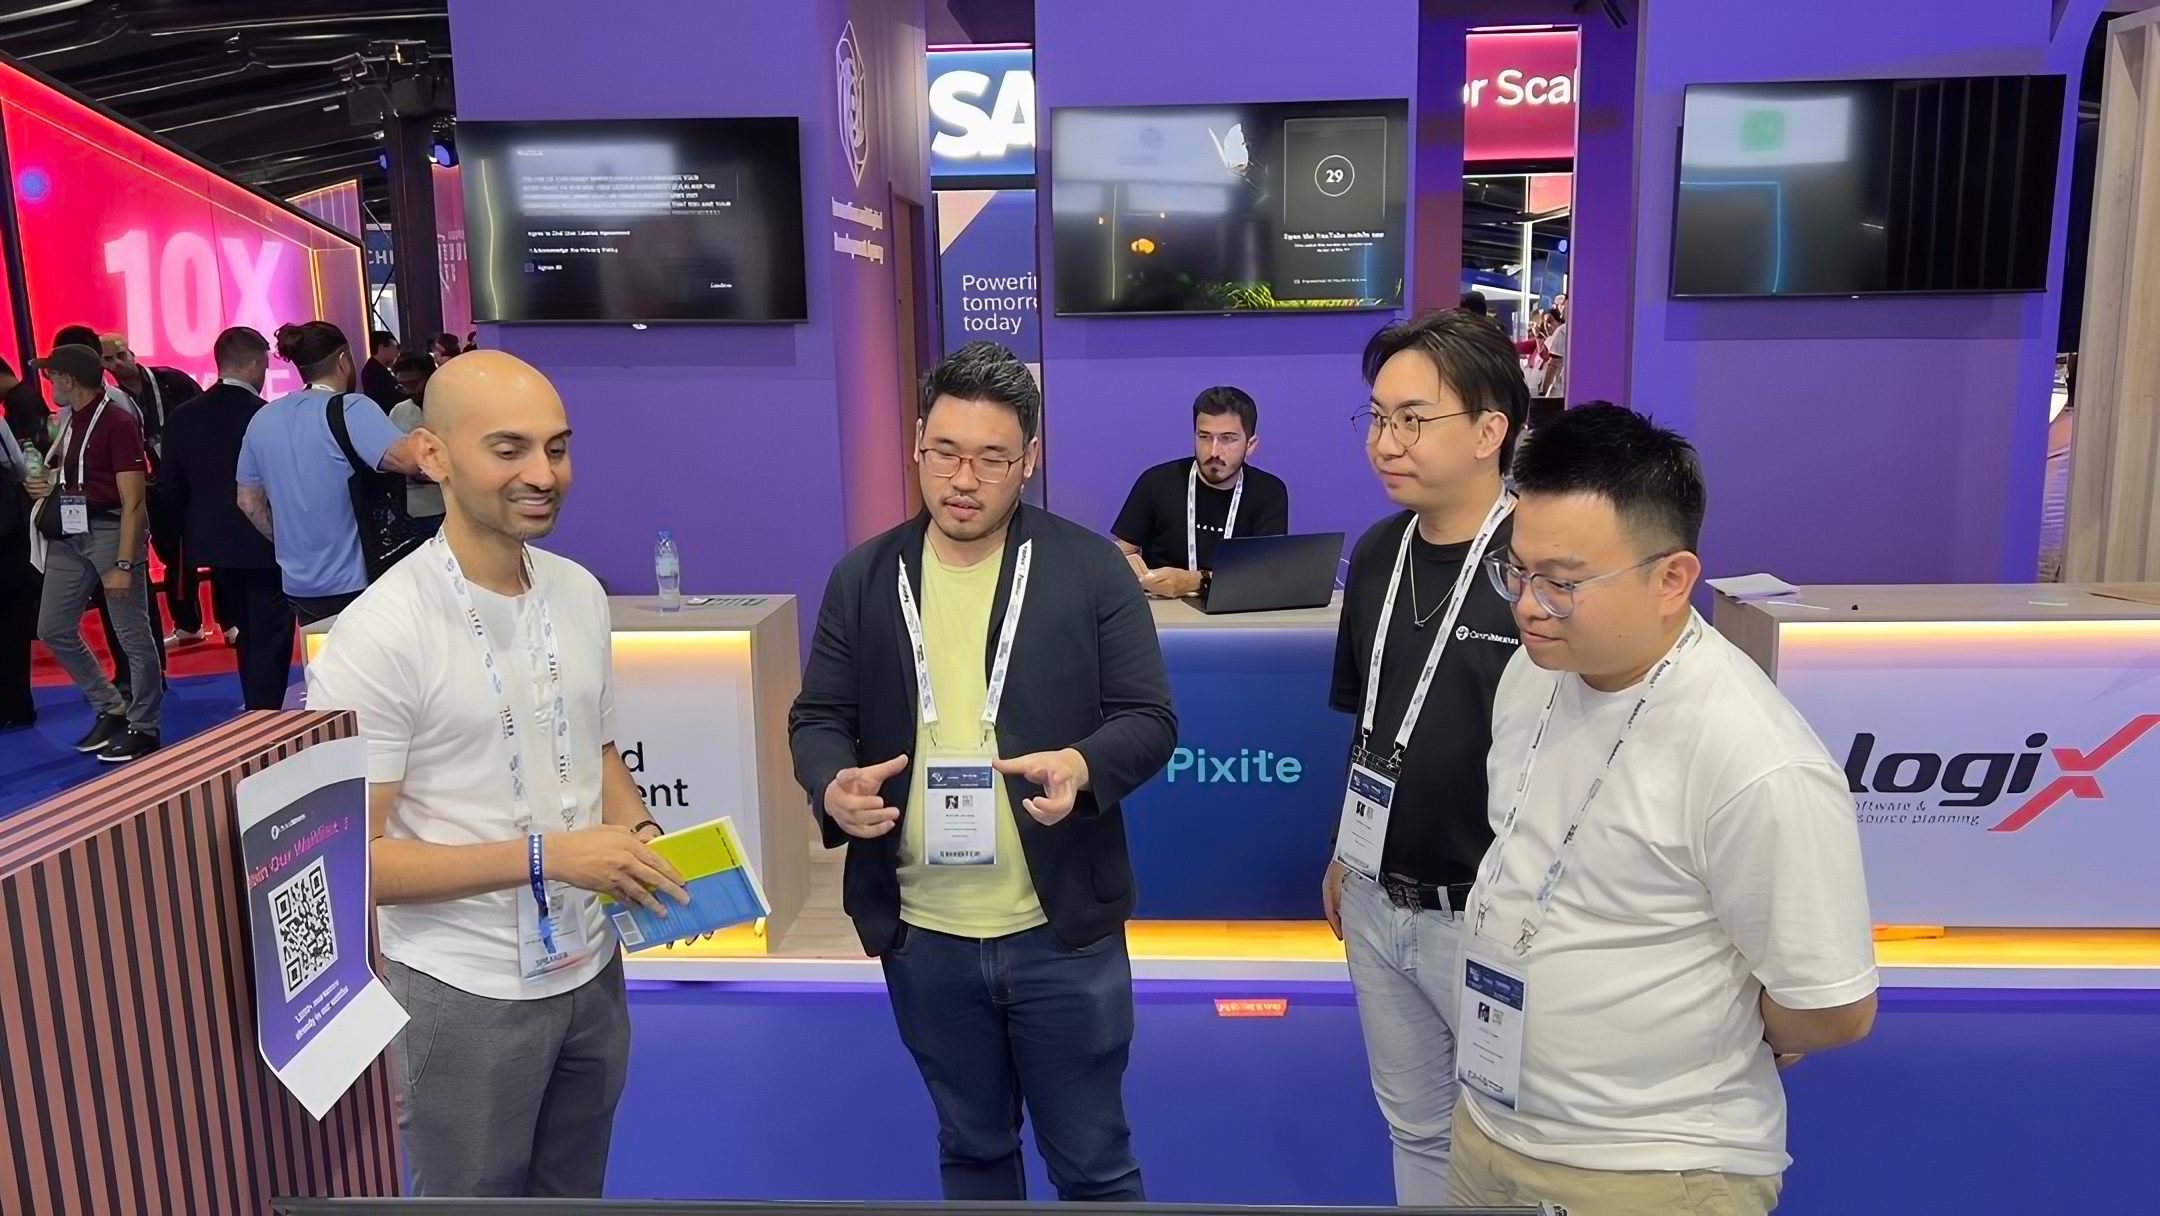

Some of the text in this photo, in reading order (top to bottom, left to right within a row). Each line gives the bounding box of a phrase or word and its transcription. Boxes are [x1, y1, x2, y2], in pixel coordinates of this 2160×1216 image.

[929, 70, 1036, 157] SA
[1325, 169, 1344, 183] 29
[103, 229, 284, 357] 10X
[964, 313, 1022, 334] today
[1167, 747, 1302, 783] Pixite
